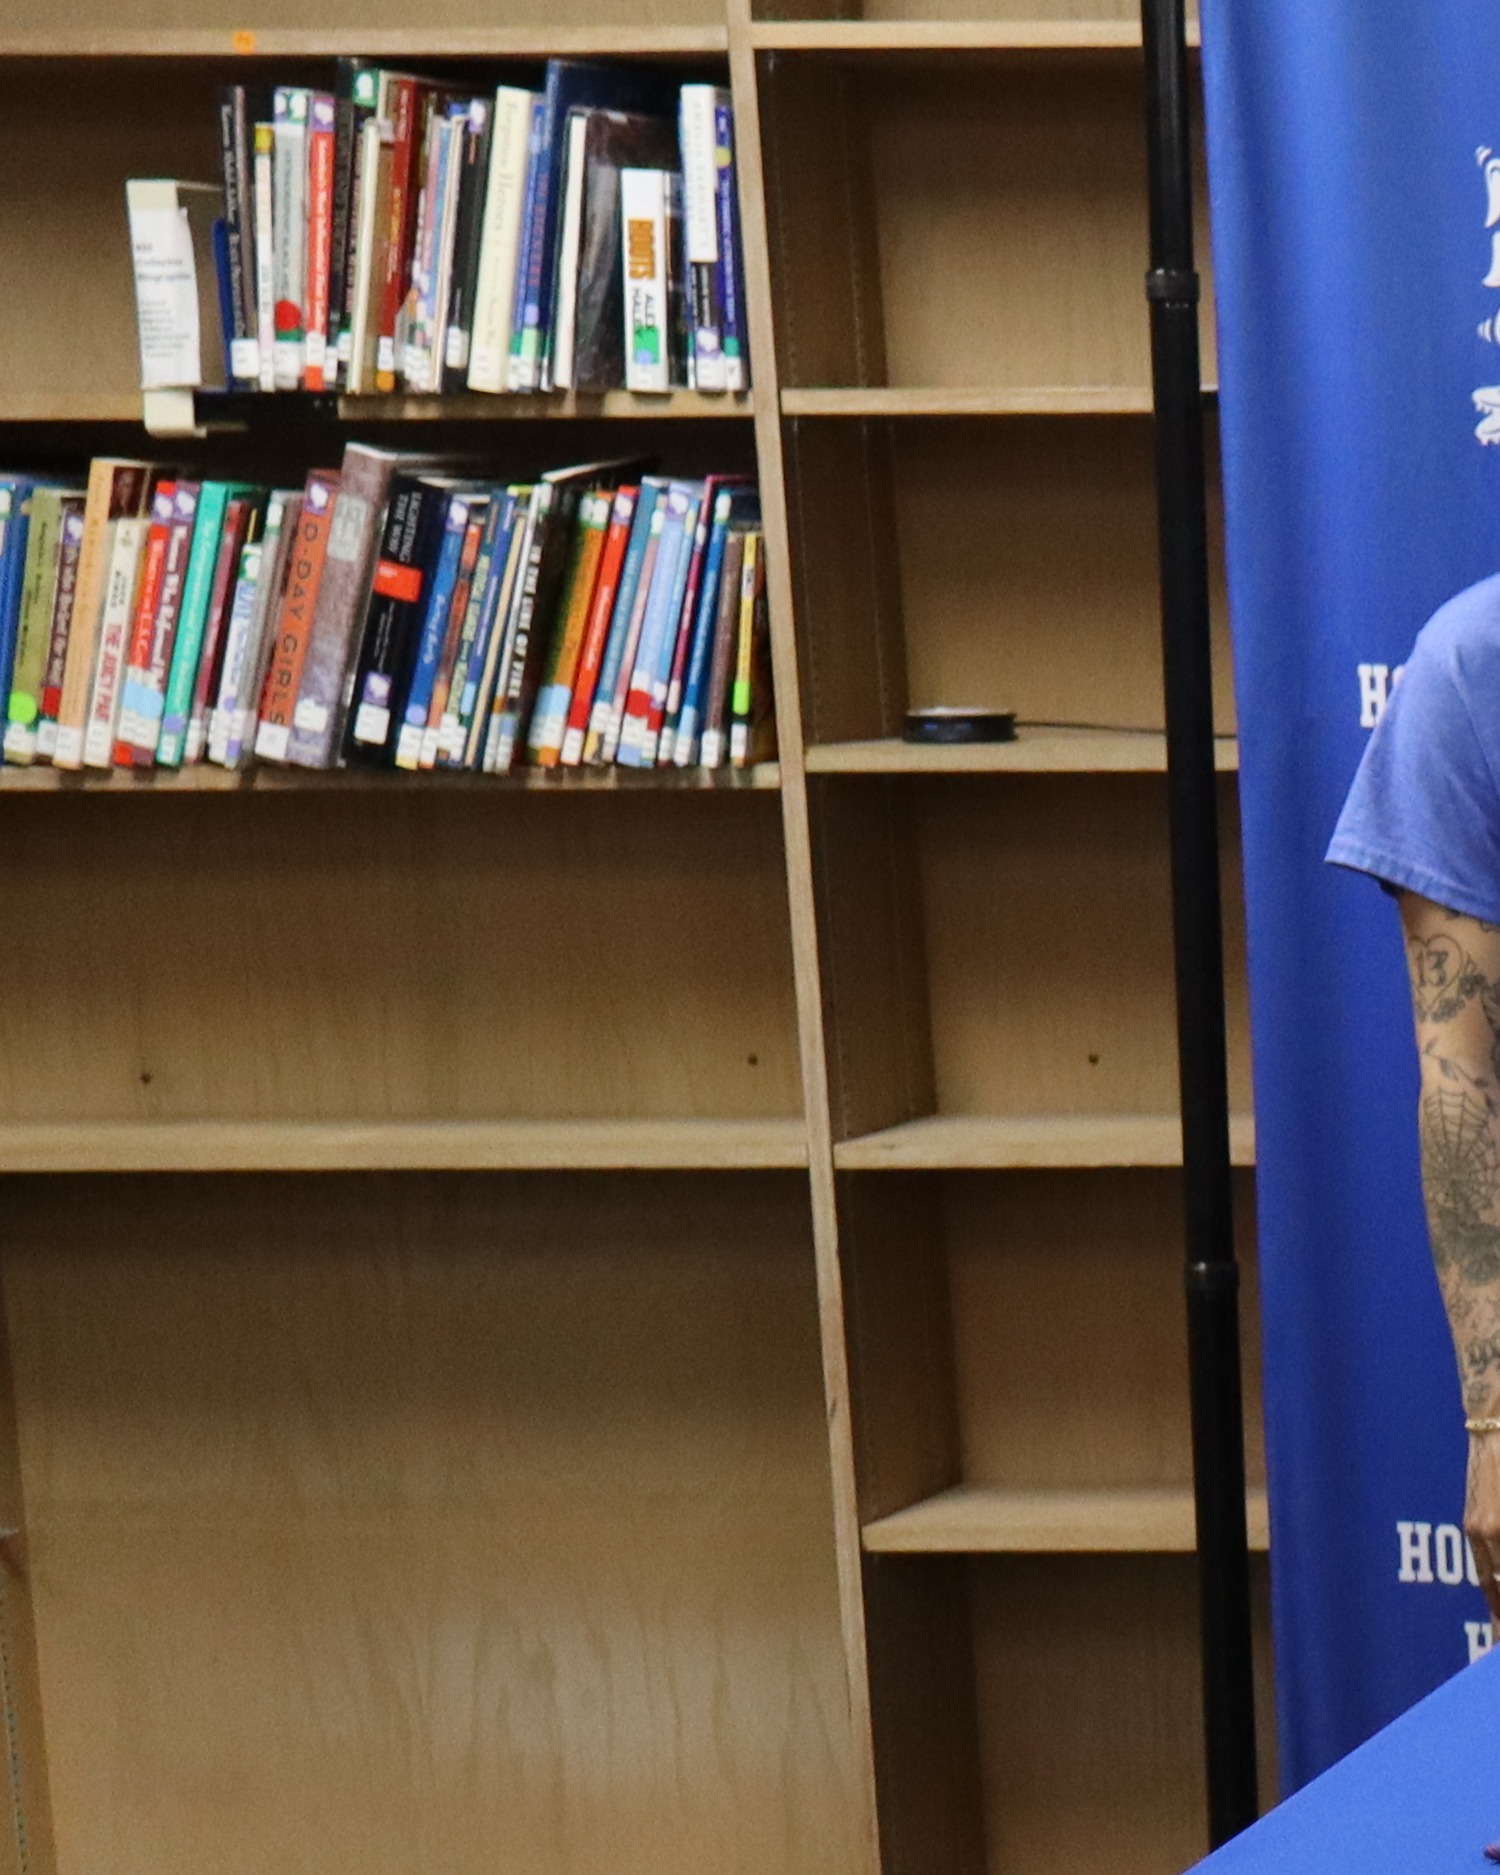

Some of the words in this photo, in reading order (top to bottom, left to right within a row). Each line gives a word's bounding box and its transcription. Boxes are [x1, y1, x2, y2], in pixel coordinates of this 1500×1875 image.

[493, 171, 514, 232] Heroes
[627, 217, 656, 281] ROOTS
[399, 492, 422, 565] LIGHTING
[289, 524, 319, 621] D-DAY
[523, 567, 539, 594] THE
[518, 596, 535, 631] LINE
[269, 634, 298, 724] GIRLS
[508, 661, 525, 699] FIRE
